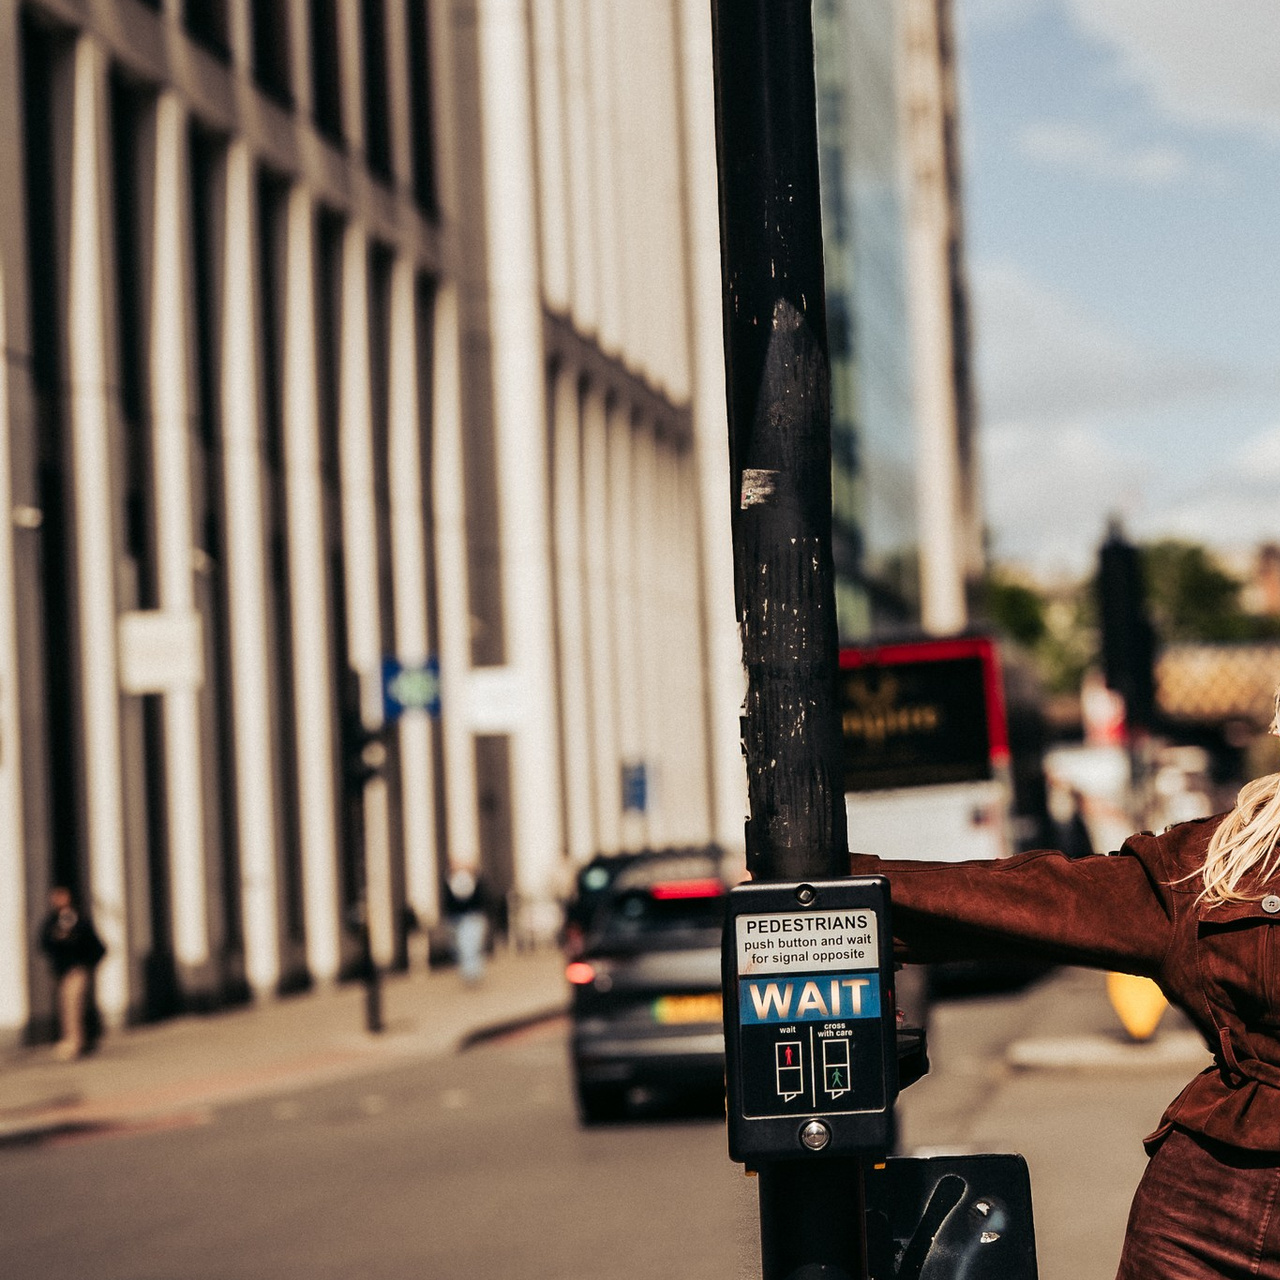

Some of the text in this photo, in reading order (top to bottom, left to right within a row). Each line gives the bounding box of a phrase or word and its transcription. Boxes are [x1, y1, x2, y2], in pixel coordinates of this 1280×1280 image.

[746, 915, 868, 934] PEDESTRIANS
[744, 934, 872, 952] push button and wait
[752, 949, 865, 965] for signal opposite
[749, 979, 870, 1020] WAIT
[779, 1026, 797, 1034] wait
[818, 1029, 853, 1038] with care
[823, 1022, 846, 1030] cross
